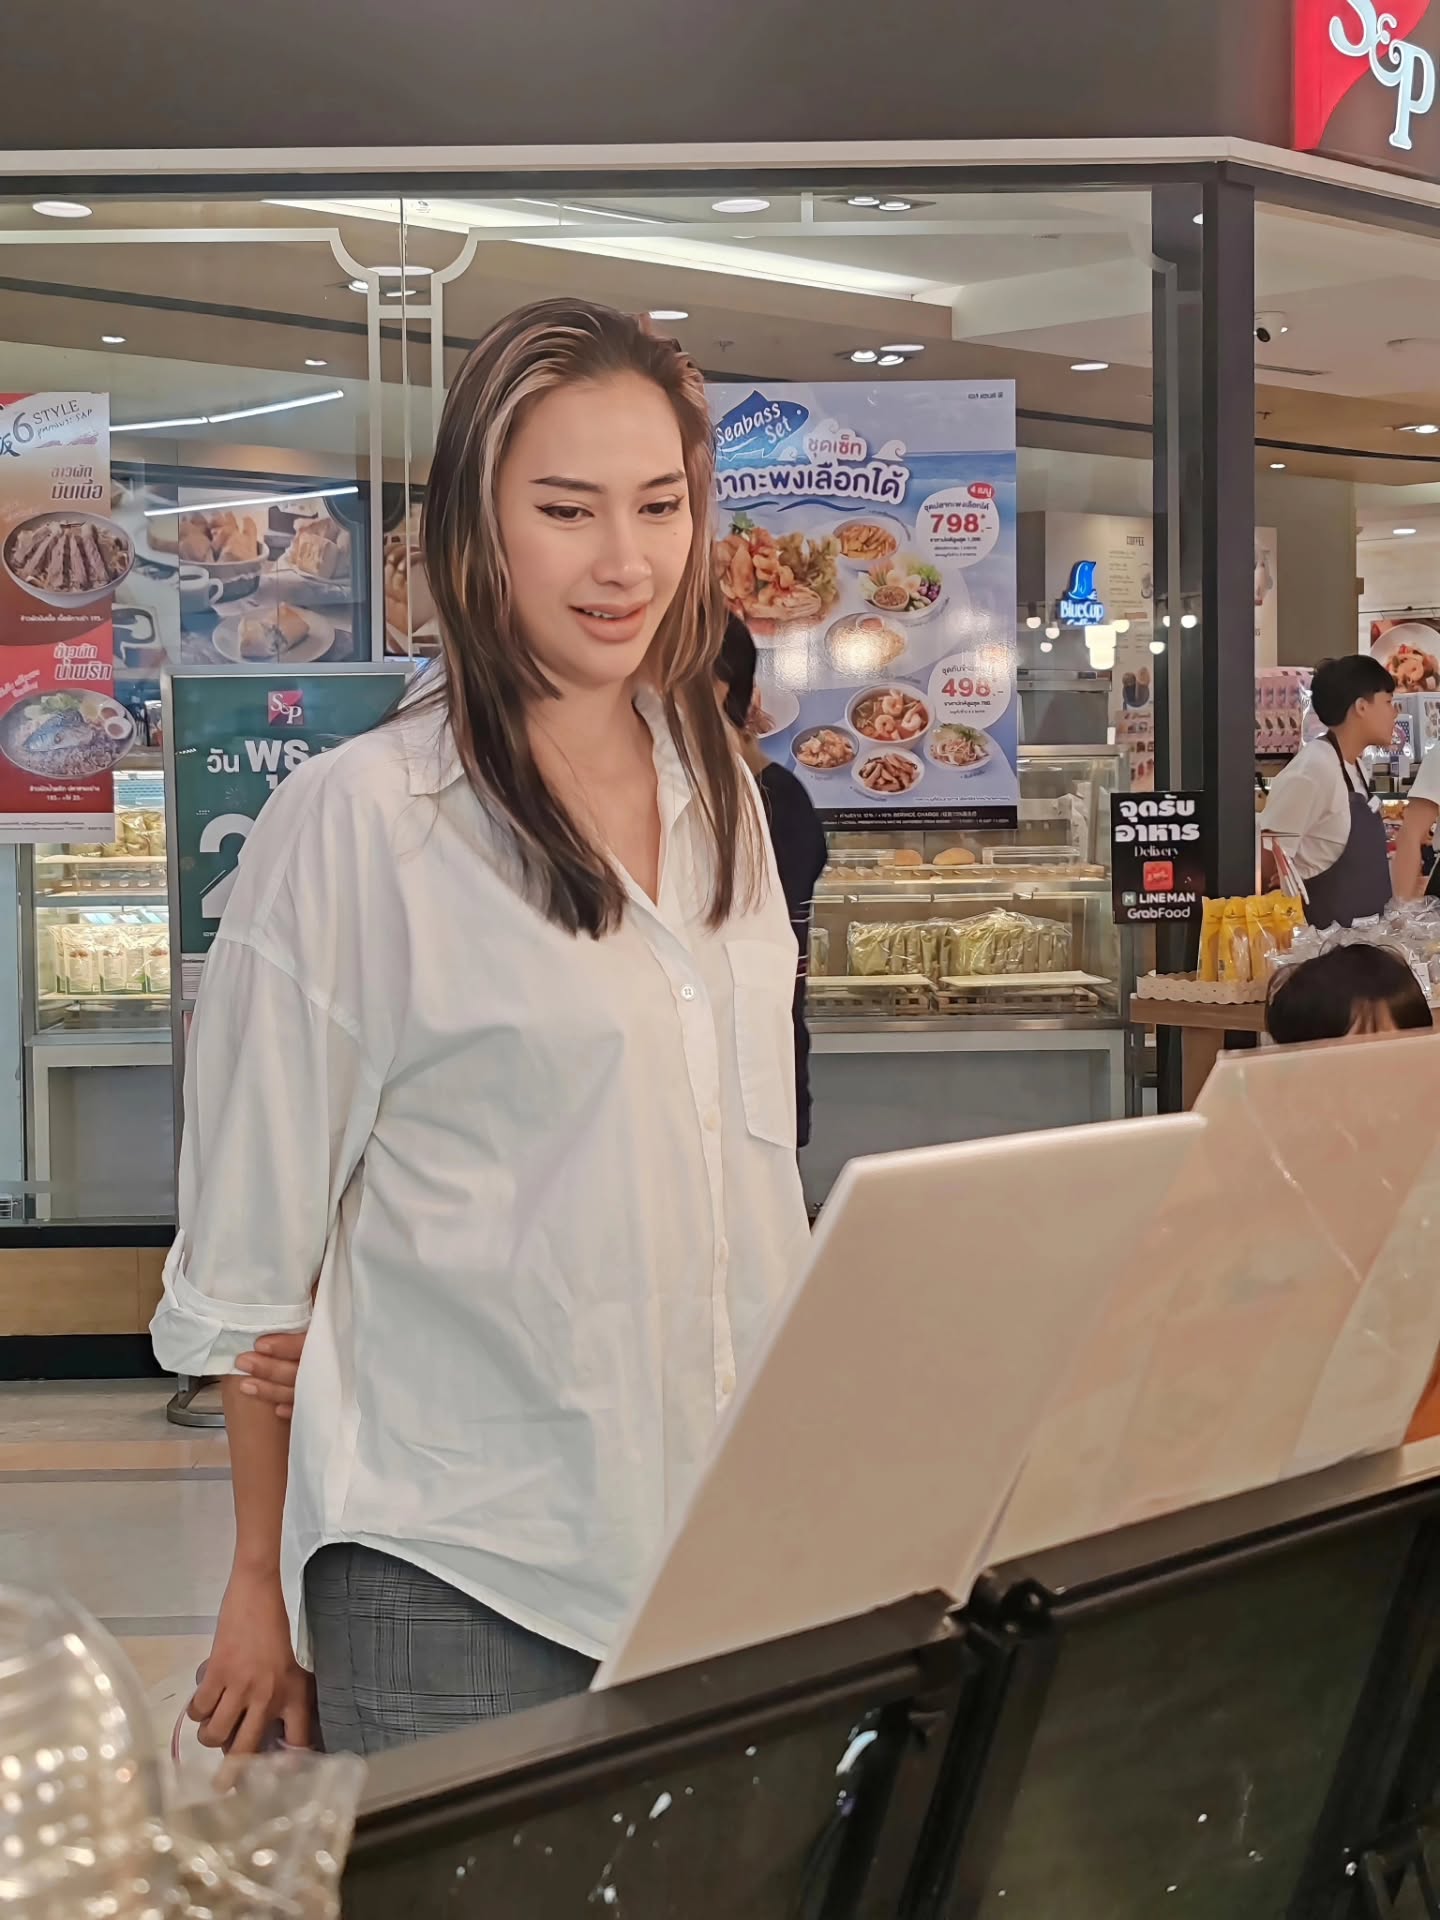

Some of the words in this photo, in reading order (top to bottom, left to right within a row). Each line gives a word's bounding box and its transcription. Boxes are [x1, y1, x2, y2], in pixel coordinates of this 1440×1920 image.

[32, 399, 80, 425] STYLE
[715, 403, 781, 446] Seabass
[765, 417, 792, 444] Set
[270, 694, 302, 725] S&P
[207, 748, 239, 773] วัน
[1119, 794, 1195, 823] จุดรับ
[1115, 823, 1200, 842] อาหาร
[1127, 906, 1190, 919] GrabFood
